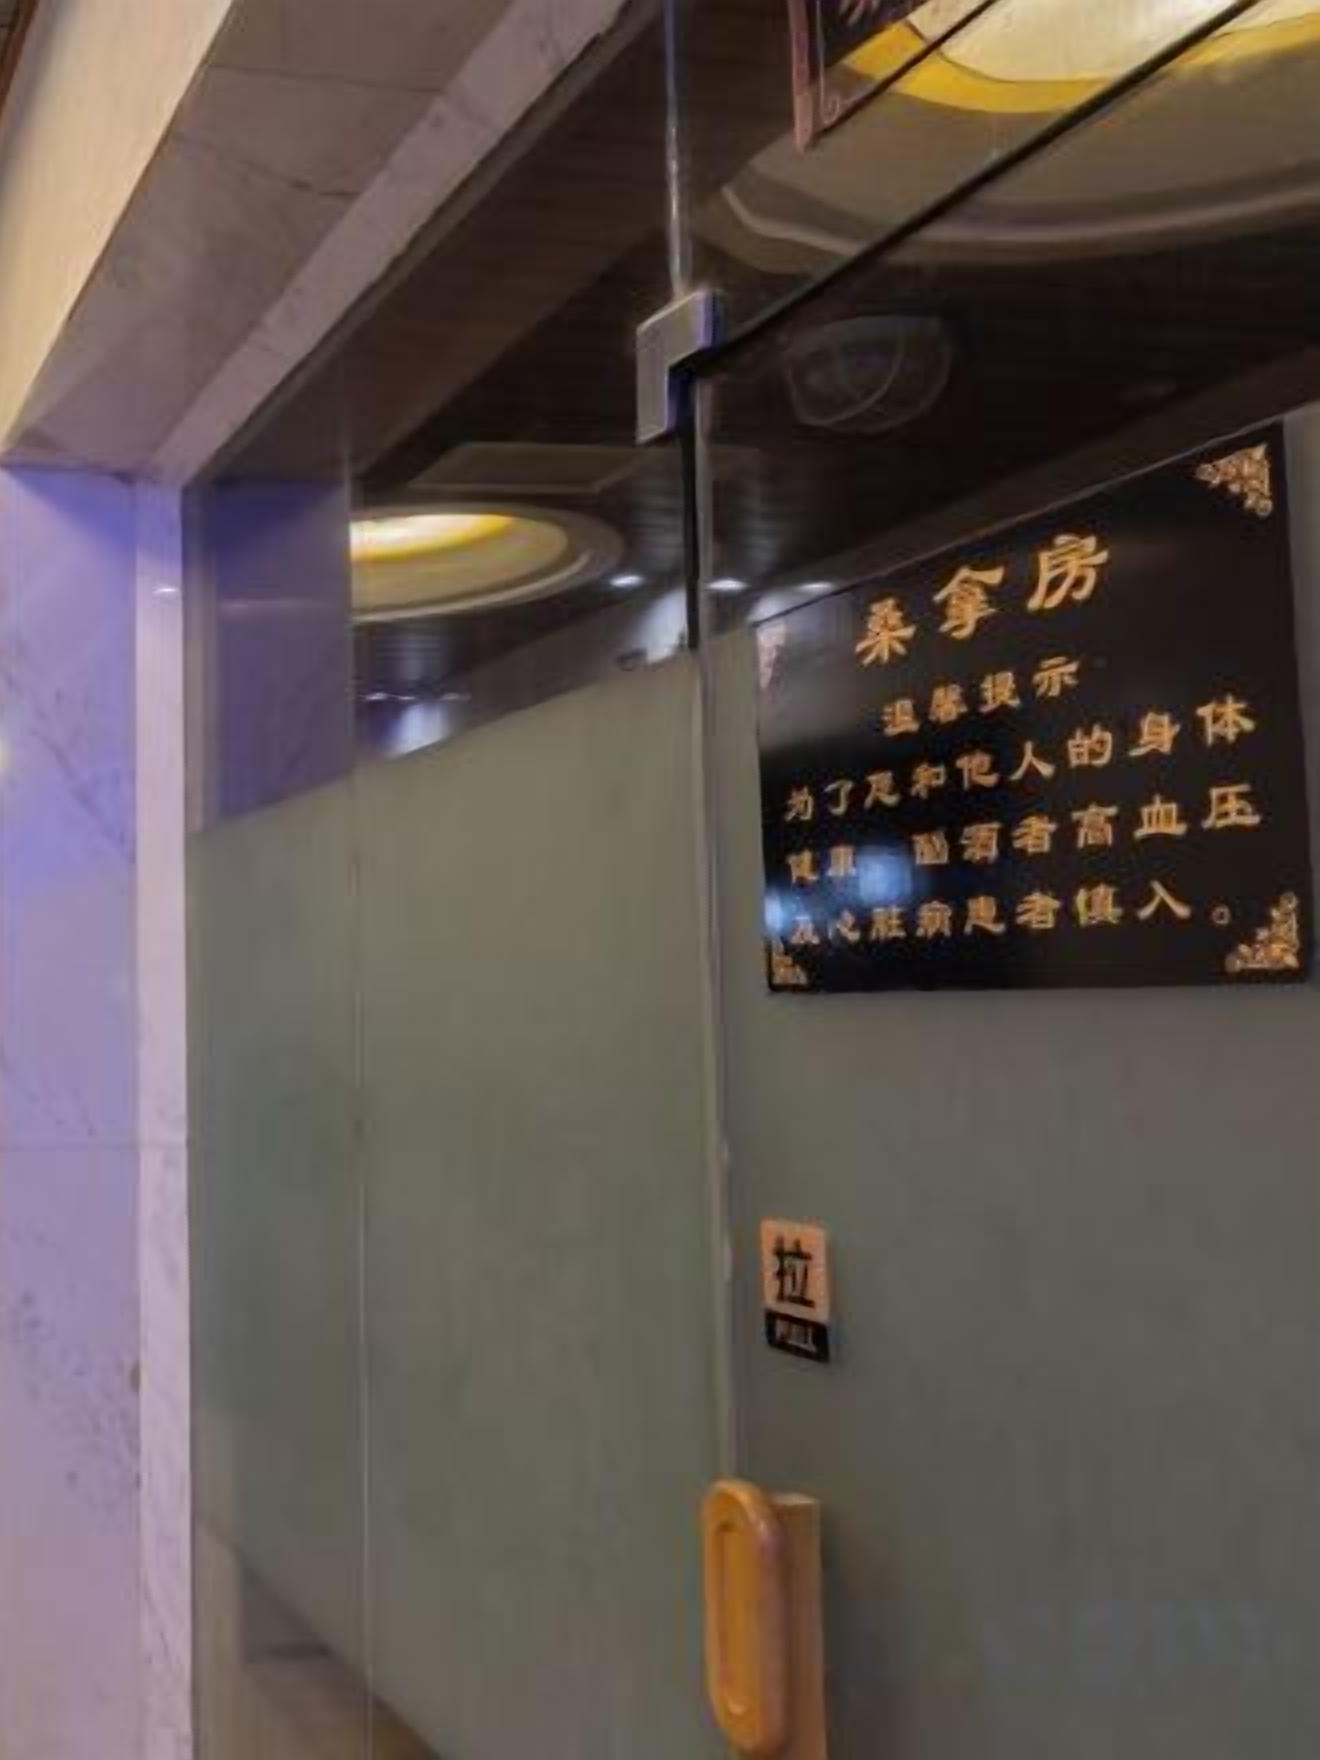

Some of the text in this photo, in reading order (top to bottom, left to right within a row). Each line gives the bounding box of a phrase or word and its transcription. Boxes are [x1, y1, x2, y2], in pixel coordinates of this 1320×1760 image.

[856, 533, 1108, 666] 桑拿房
[882, 656, 1080, 737] 温馨提示
[773, 1235, 816, 1309] 拉
